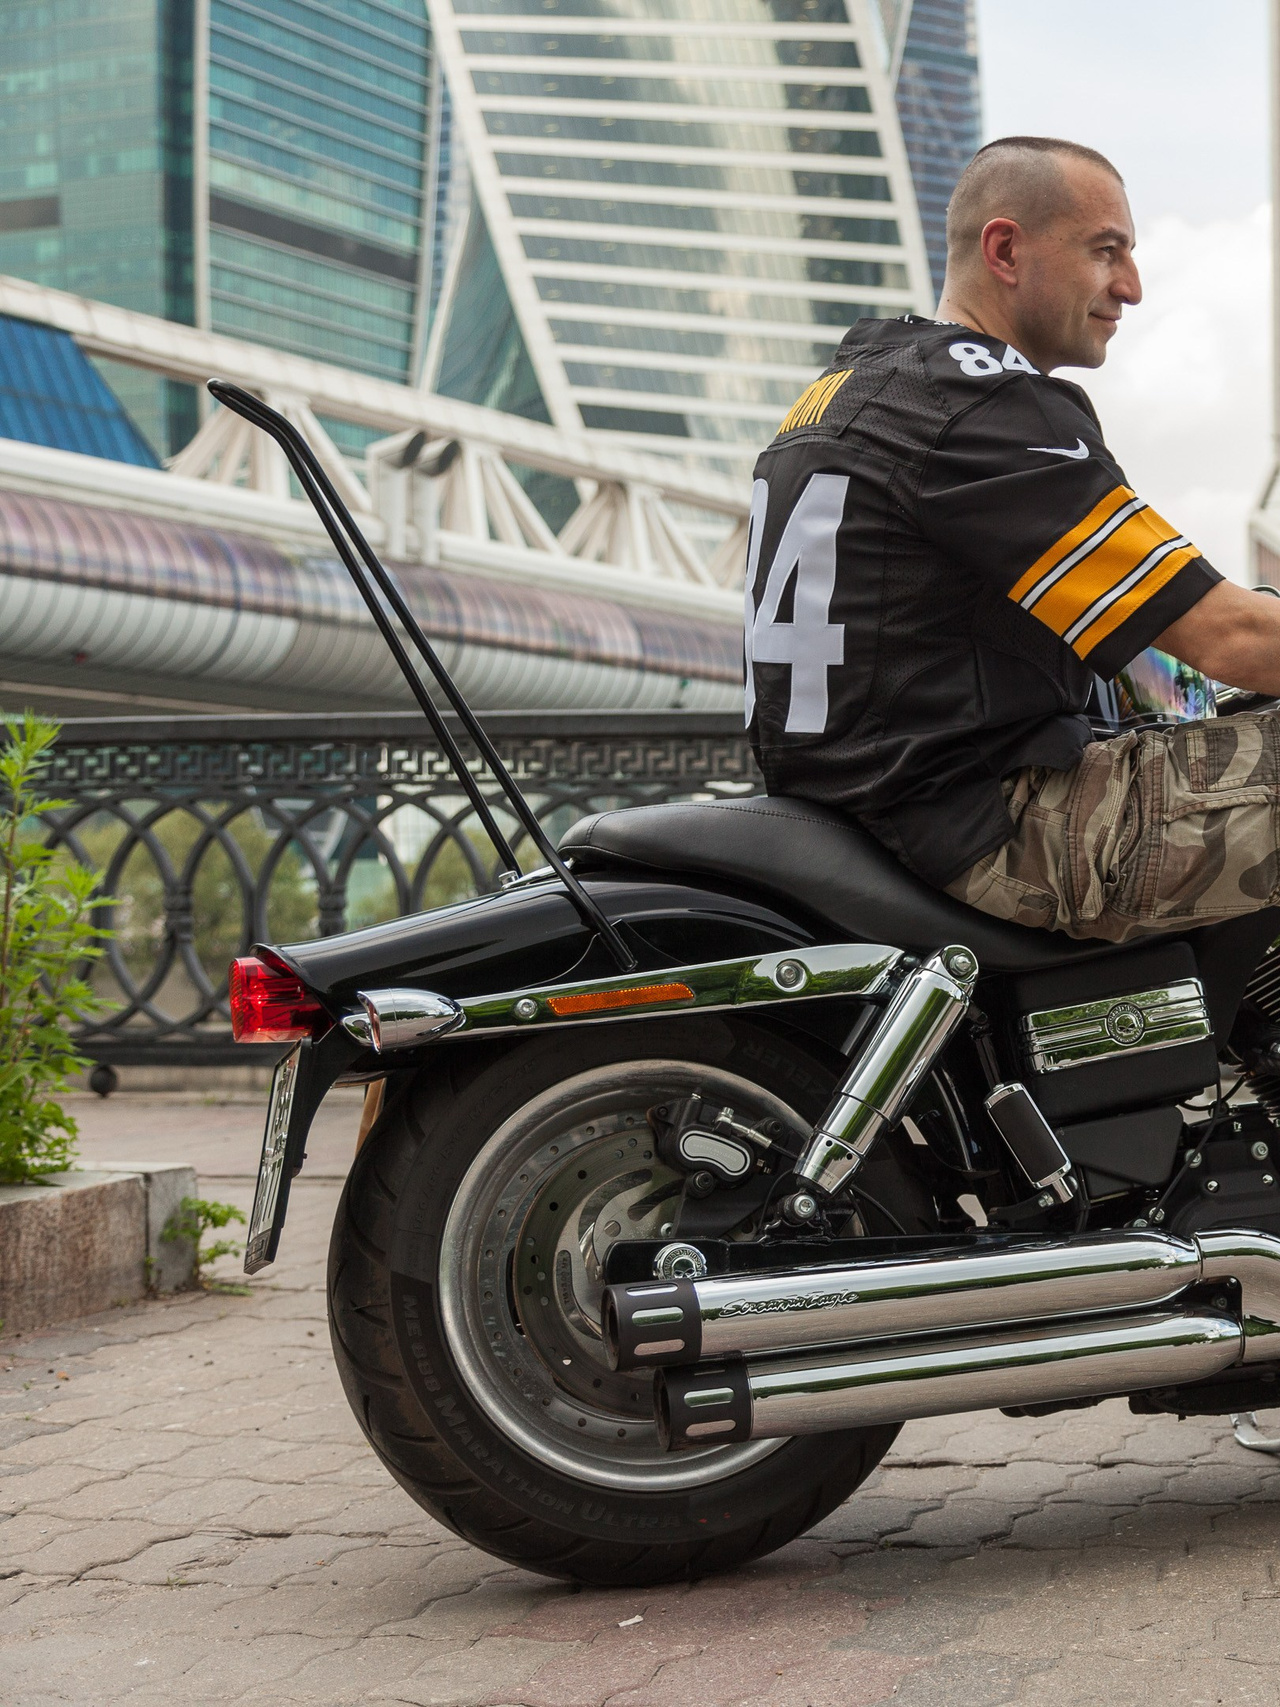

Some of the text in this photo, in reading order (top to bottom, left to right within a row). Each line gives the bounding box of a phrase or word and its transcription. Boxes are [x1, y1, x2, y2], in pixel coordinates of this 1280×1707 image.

[776, 369, 854, 436] ROWN
[742, 1038, 828, 1096] ZELER
[402, 1294, 681, 1530] ME 888 MARATHON ULTRA
